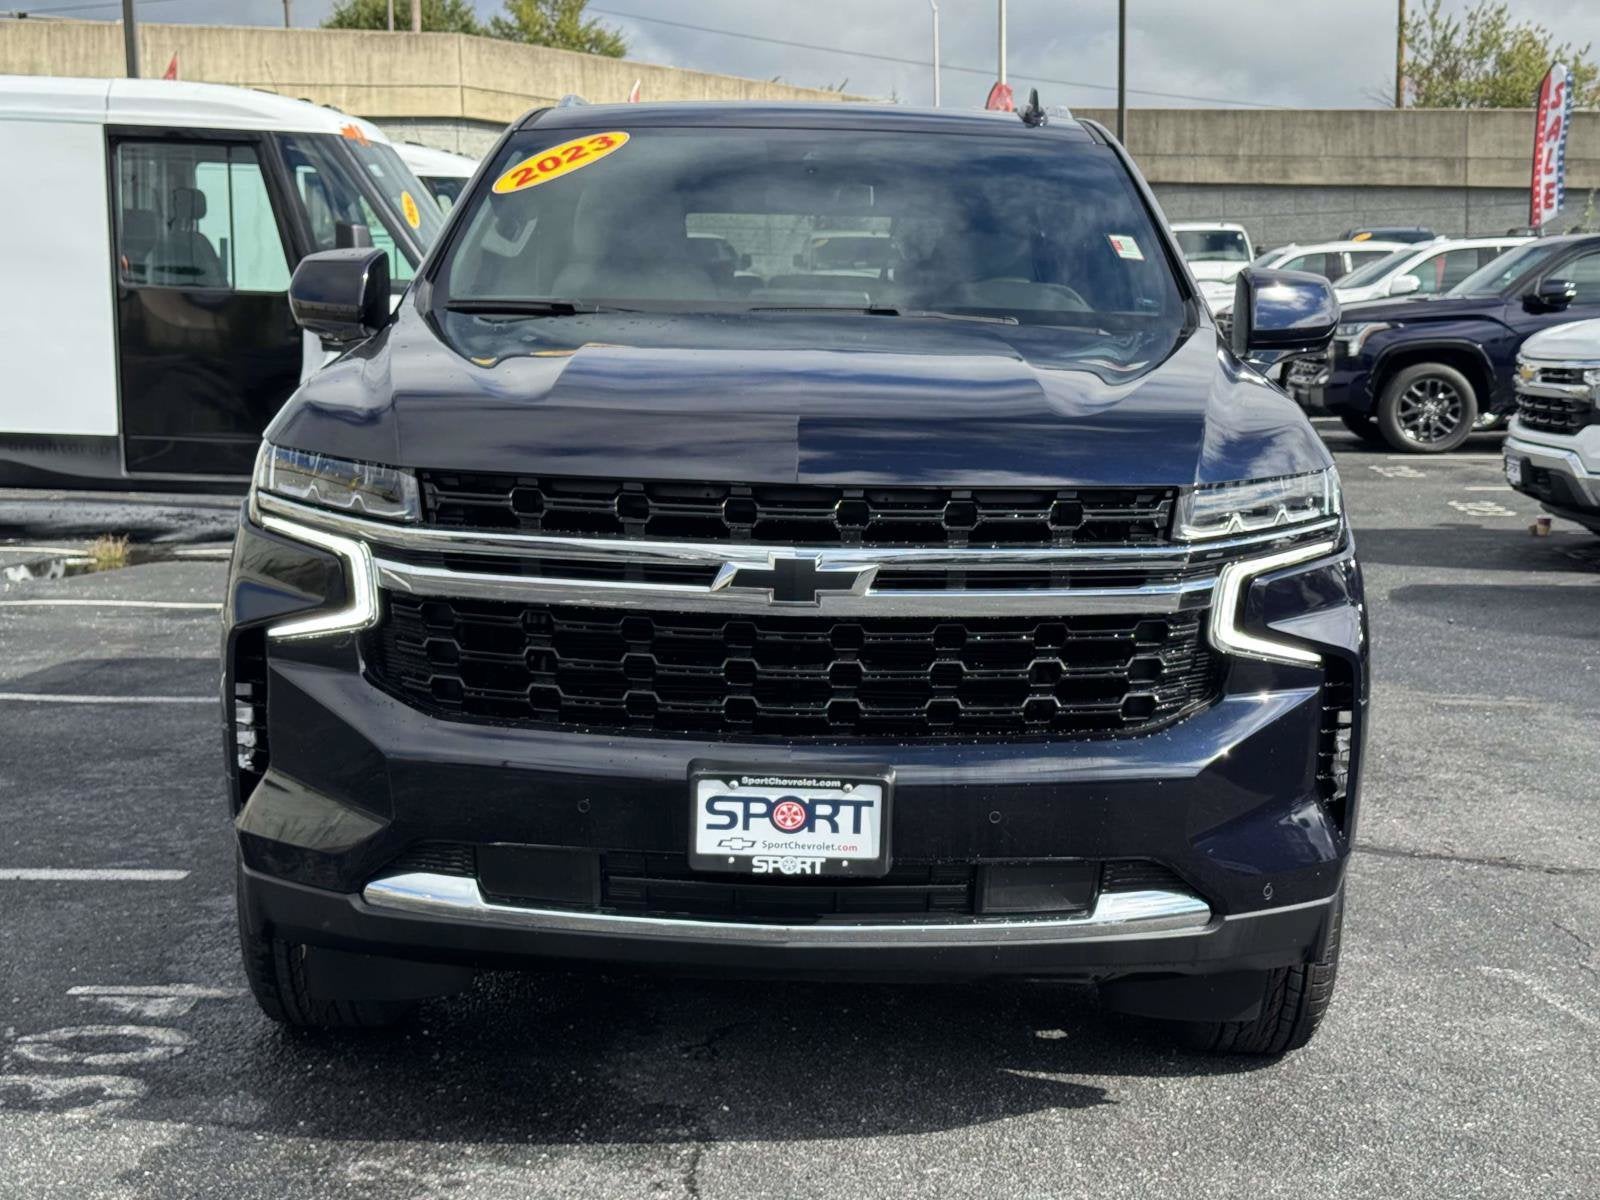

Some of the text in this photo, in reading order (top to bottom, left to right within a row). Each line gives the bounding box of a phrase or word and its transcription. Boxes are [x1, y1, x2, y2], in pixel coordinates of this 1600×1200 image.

[1544, 81, 1565, 209] SALE
[510, 136, 616, 188] 2023
[741, 776, 841, 787] SportChevrolet.com
[705, 795, 873, 834] SPORT
[762, 840, 858, 852] SportChevrolet.com
[751, 855, 826, 875] SPORT
